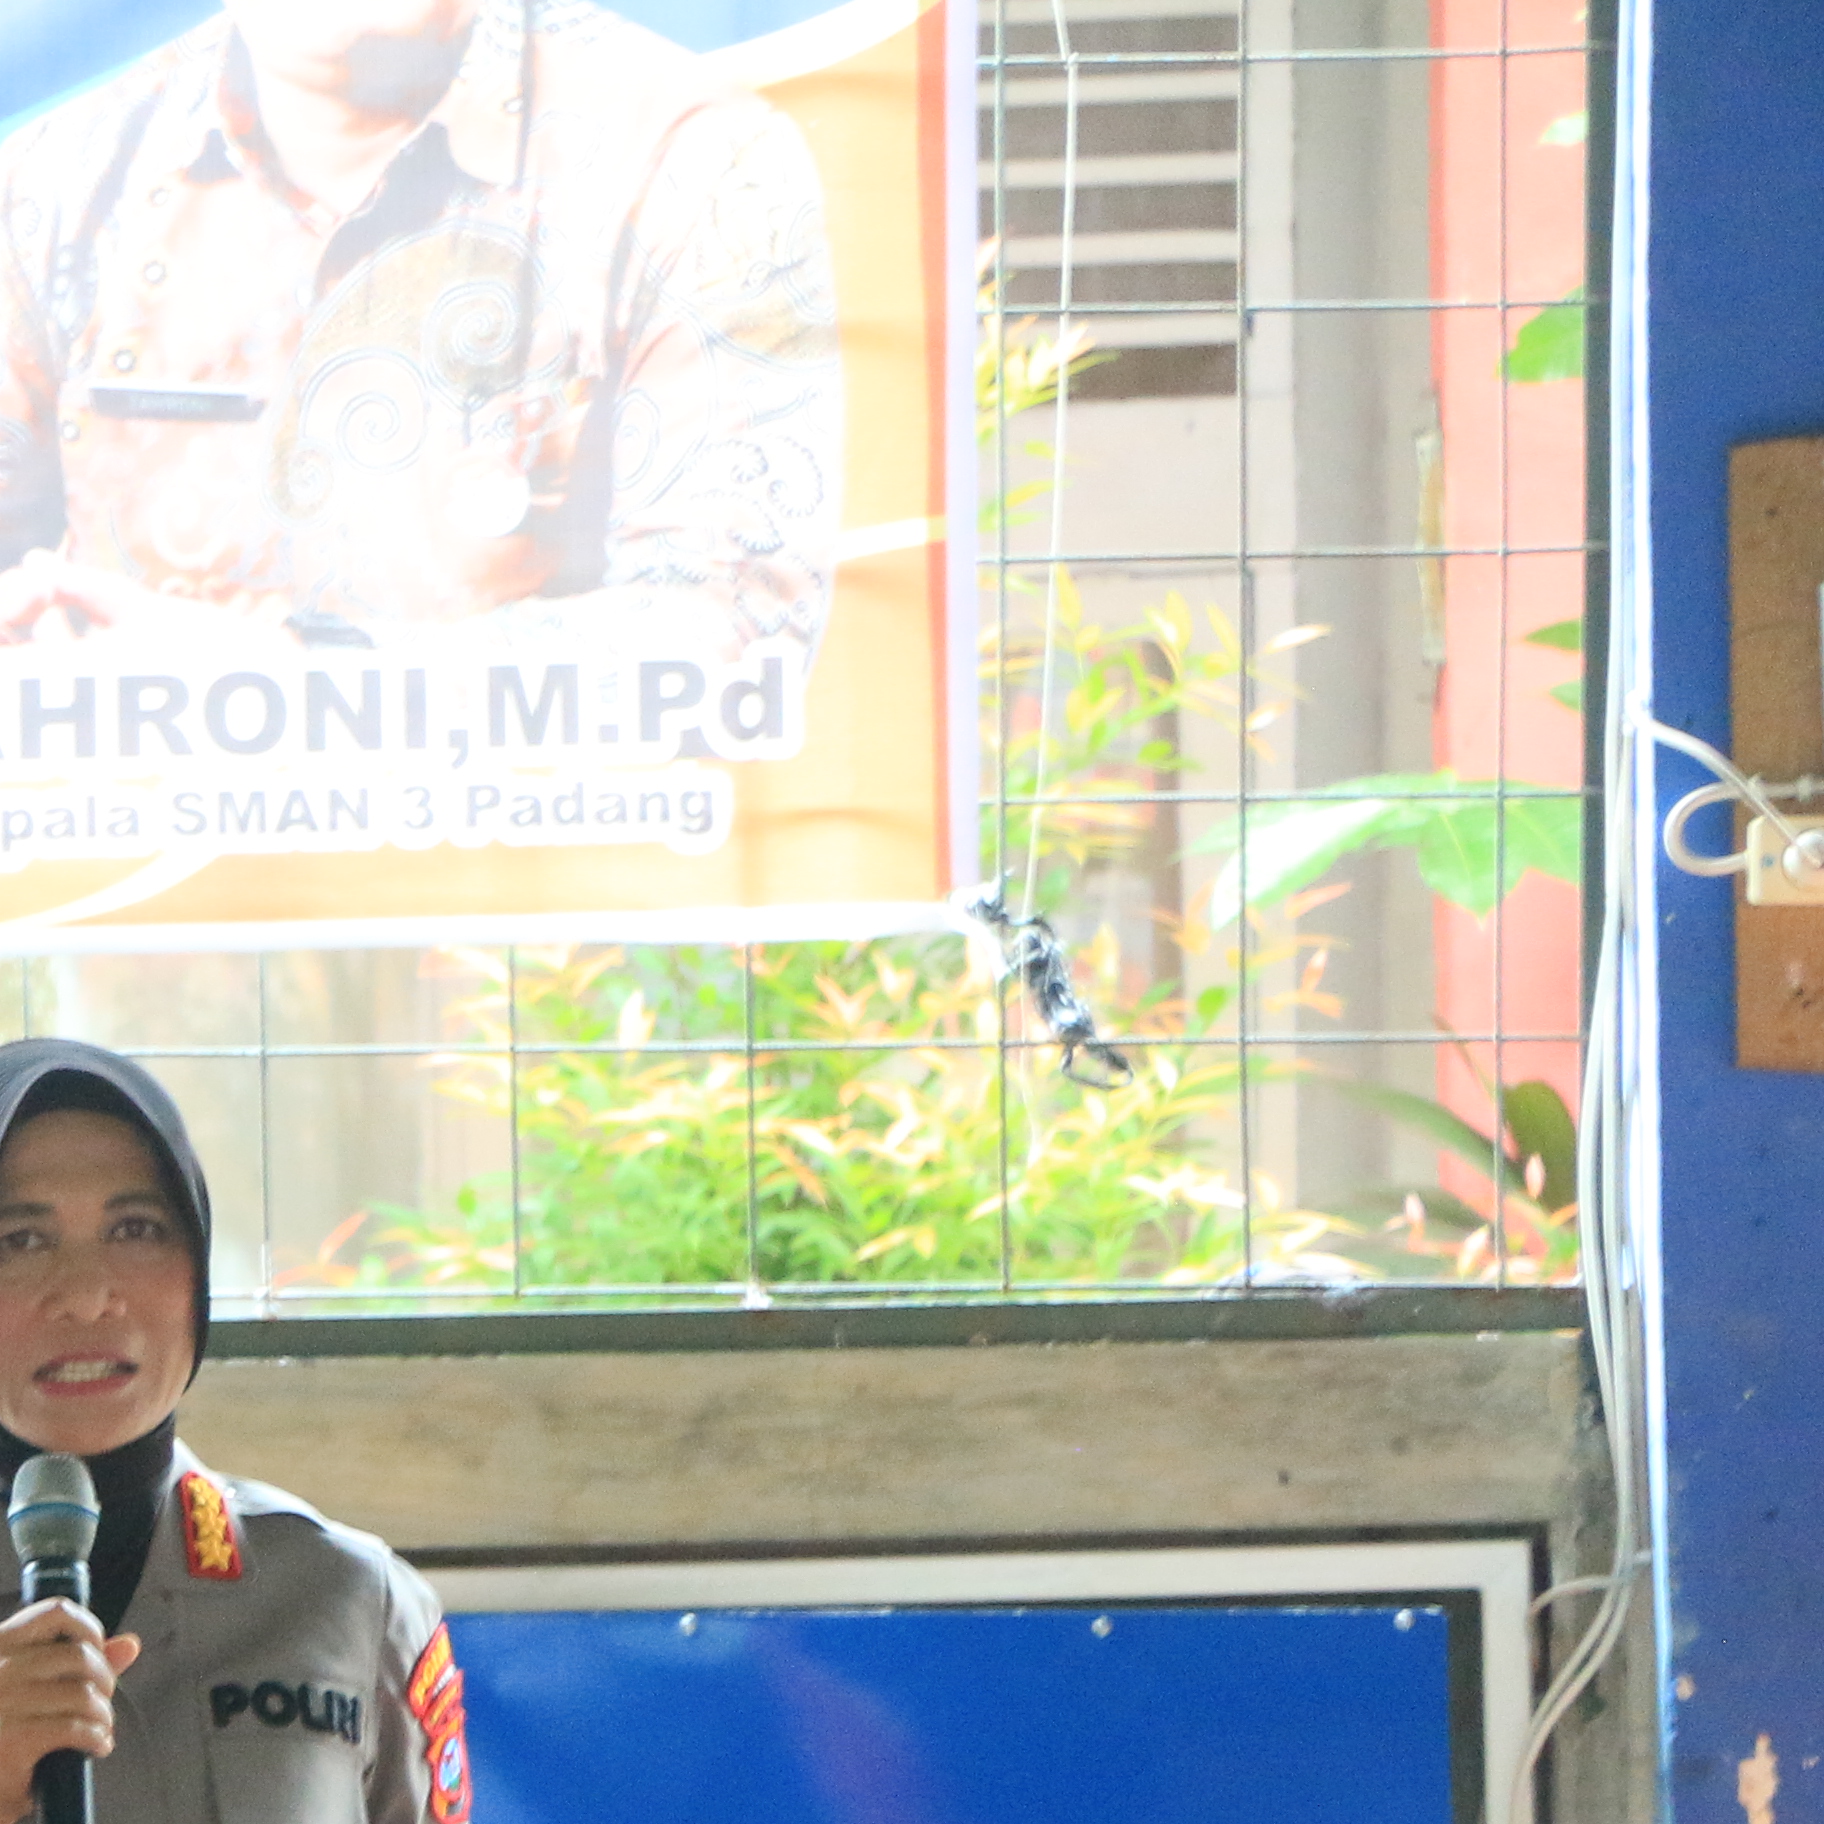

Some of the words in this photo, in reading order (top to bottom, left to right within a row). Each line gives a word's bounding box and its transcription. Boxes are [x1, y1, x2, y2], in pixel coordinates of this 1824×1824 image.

[170, 786, 370, 836] SMAN
[402, 785, 433, 832] 3
[465, 781, 717, 837] Padang
[208, 1680, 362, 1745] POLRI
